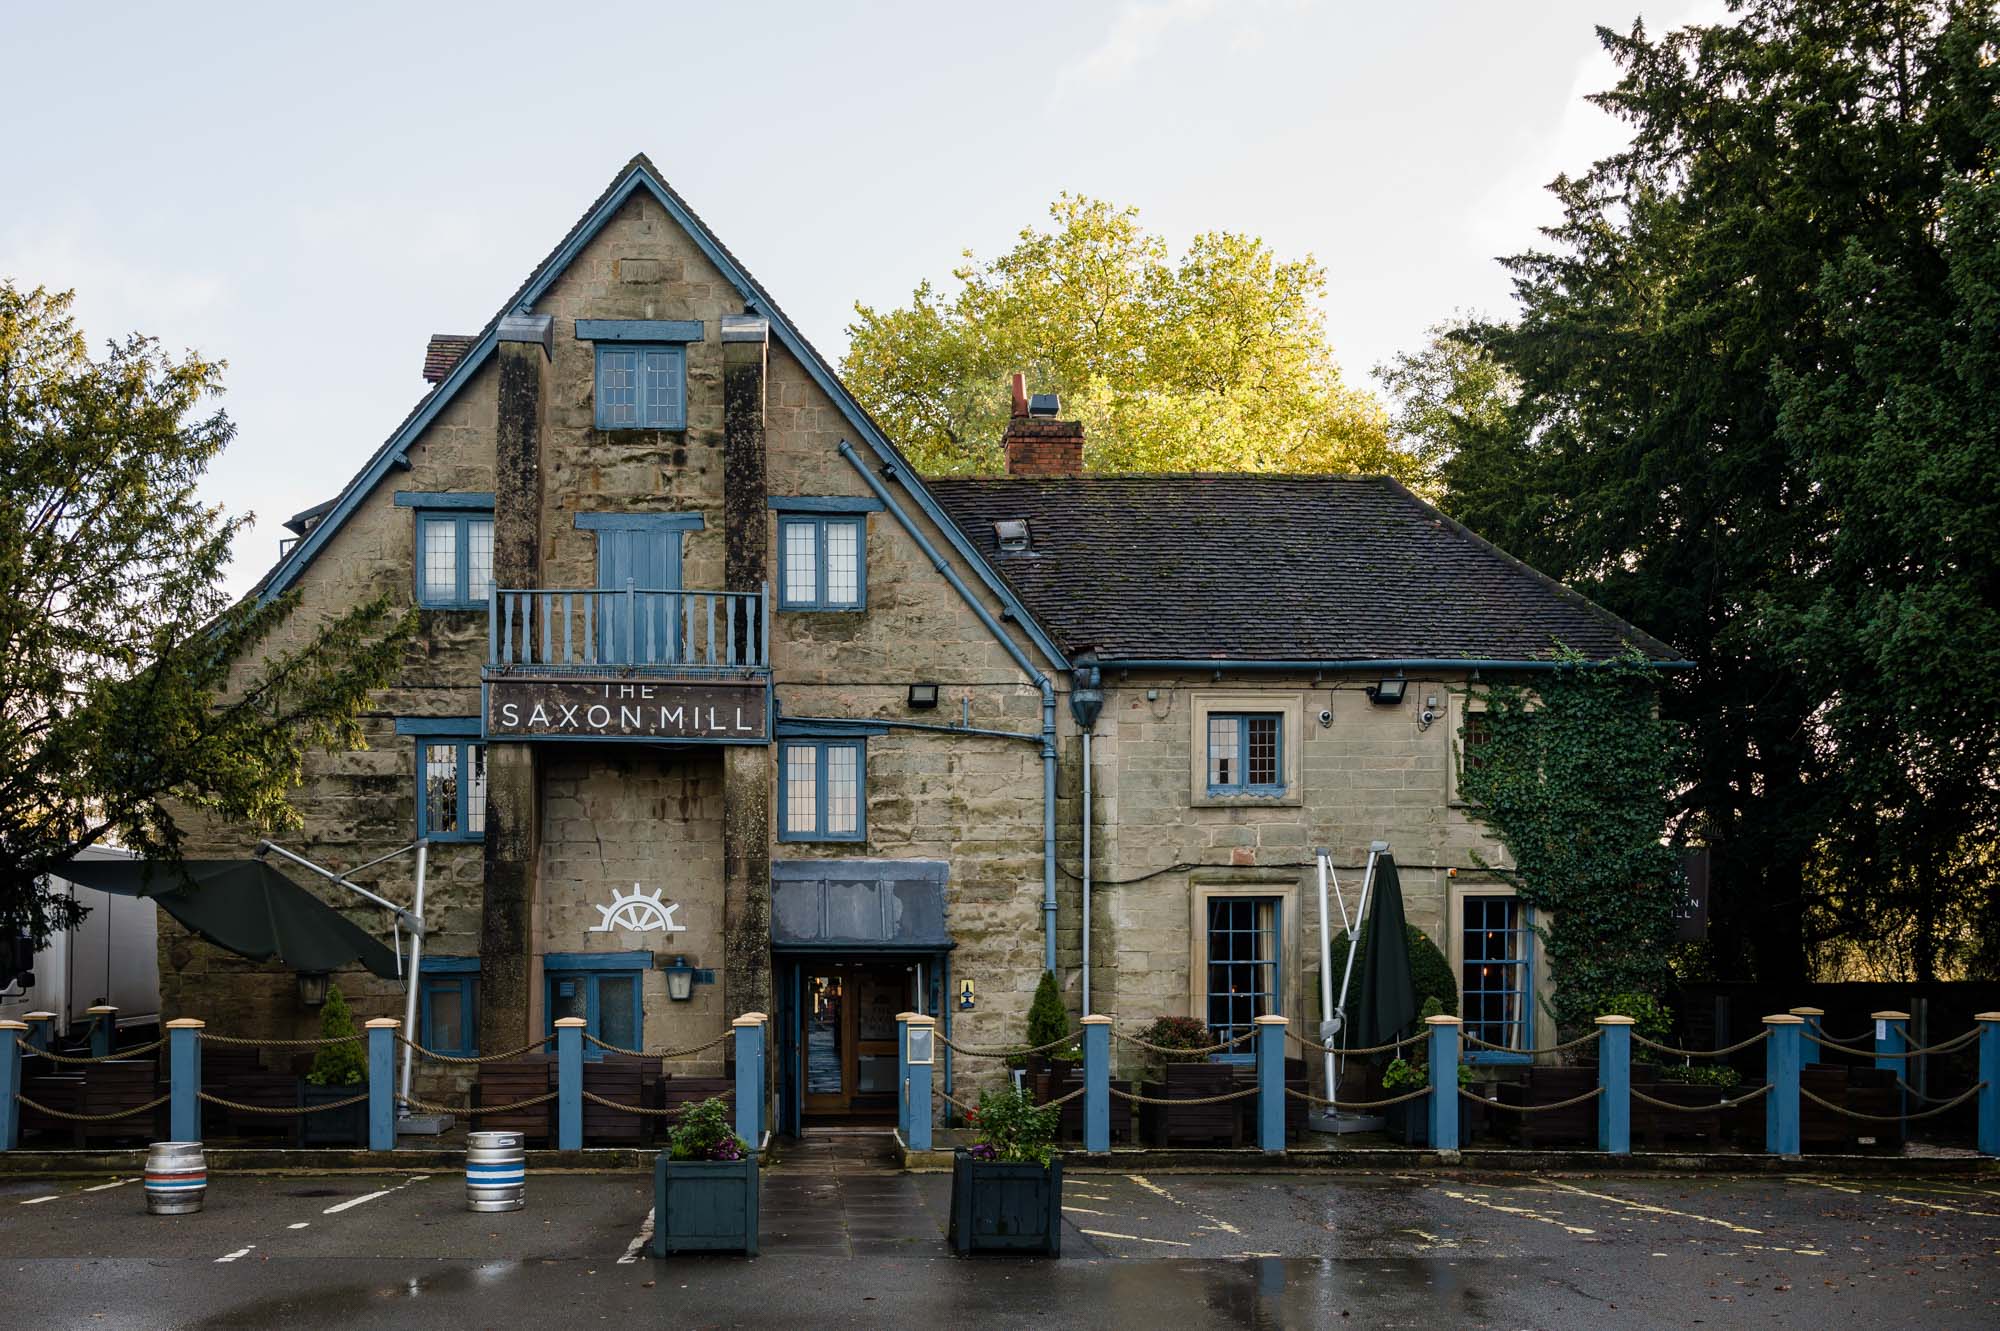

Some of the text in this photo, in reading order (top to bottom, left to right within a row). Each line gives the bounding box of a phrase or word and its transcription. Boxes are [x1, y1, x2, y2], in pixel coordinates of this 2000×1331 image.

[605, 684, 654, 699] THE
[501, 703, 753, 731] SAXON MILL
